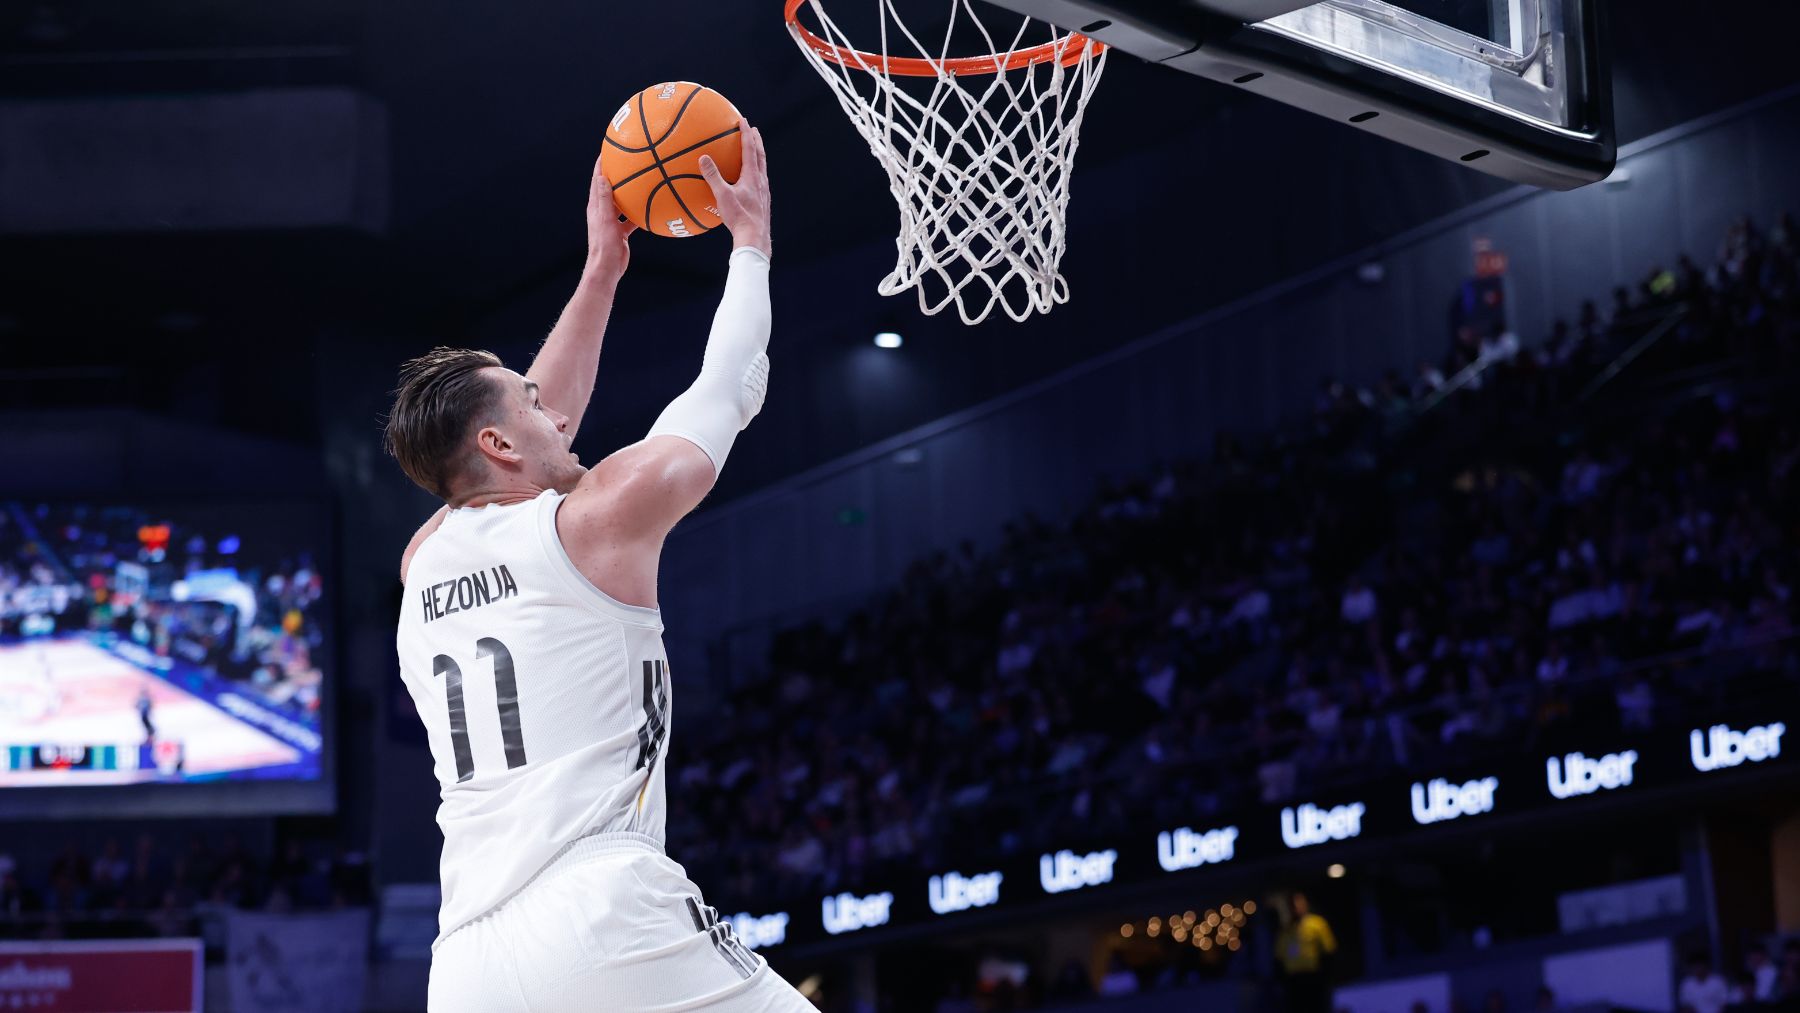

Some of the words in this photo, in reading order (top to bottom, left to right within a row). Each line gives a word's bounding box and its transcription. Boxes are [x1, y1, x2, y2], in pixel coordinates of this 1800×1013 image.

[421, 564, 518, 623] HEZONJA
[432, 636, 527, 783] 11
[822, 892, 892, 934] Uber
[928, 872, 1002, 914] Uber
[1039, 850, 1117, 893] Uber
[1157, 827, 1238, 871] Uber
[1281, 803, 1364, 848] Uber
[1411, 777, 1498, 824] Uber
[1546, 750, 1637, 798] Uber
[1690, 722, 1785, 771] Uber
